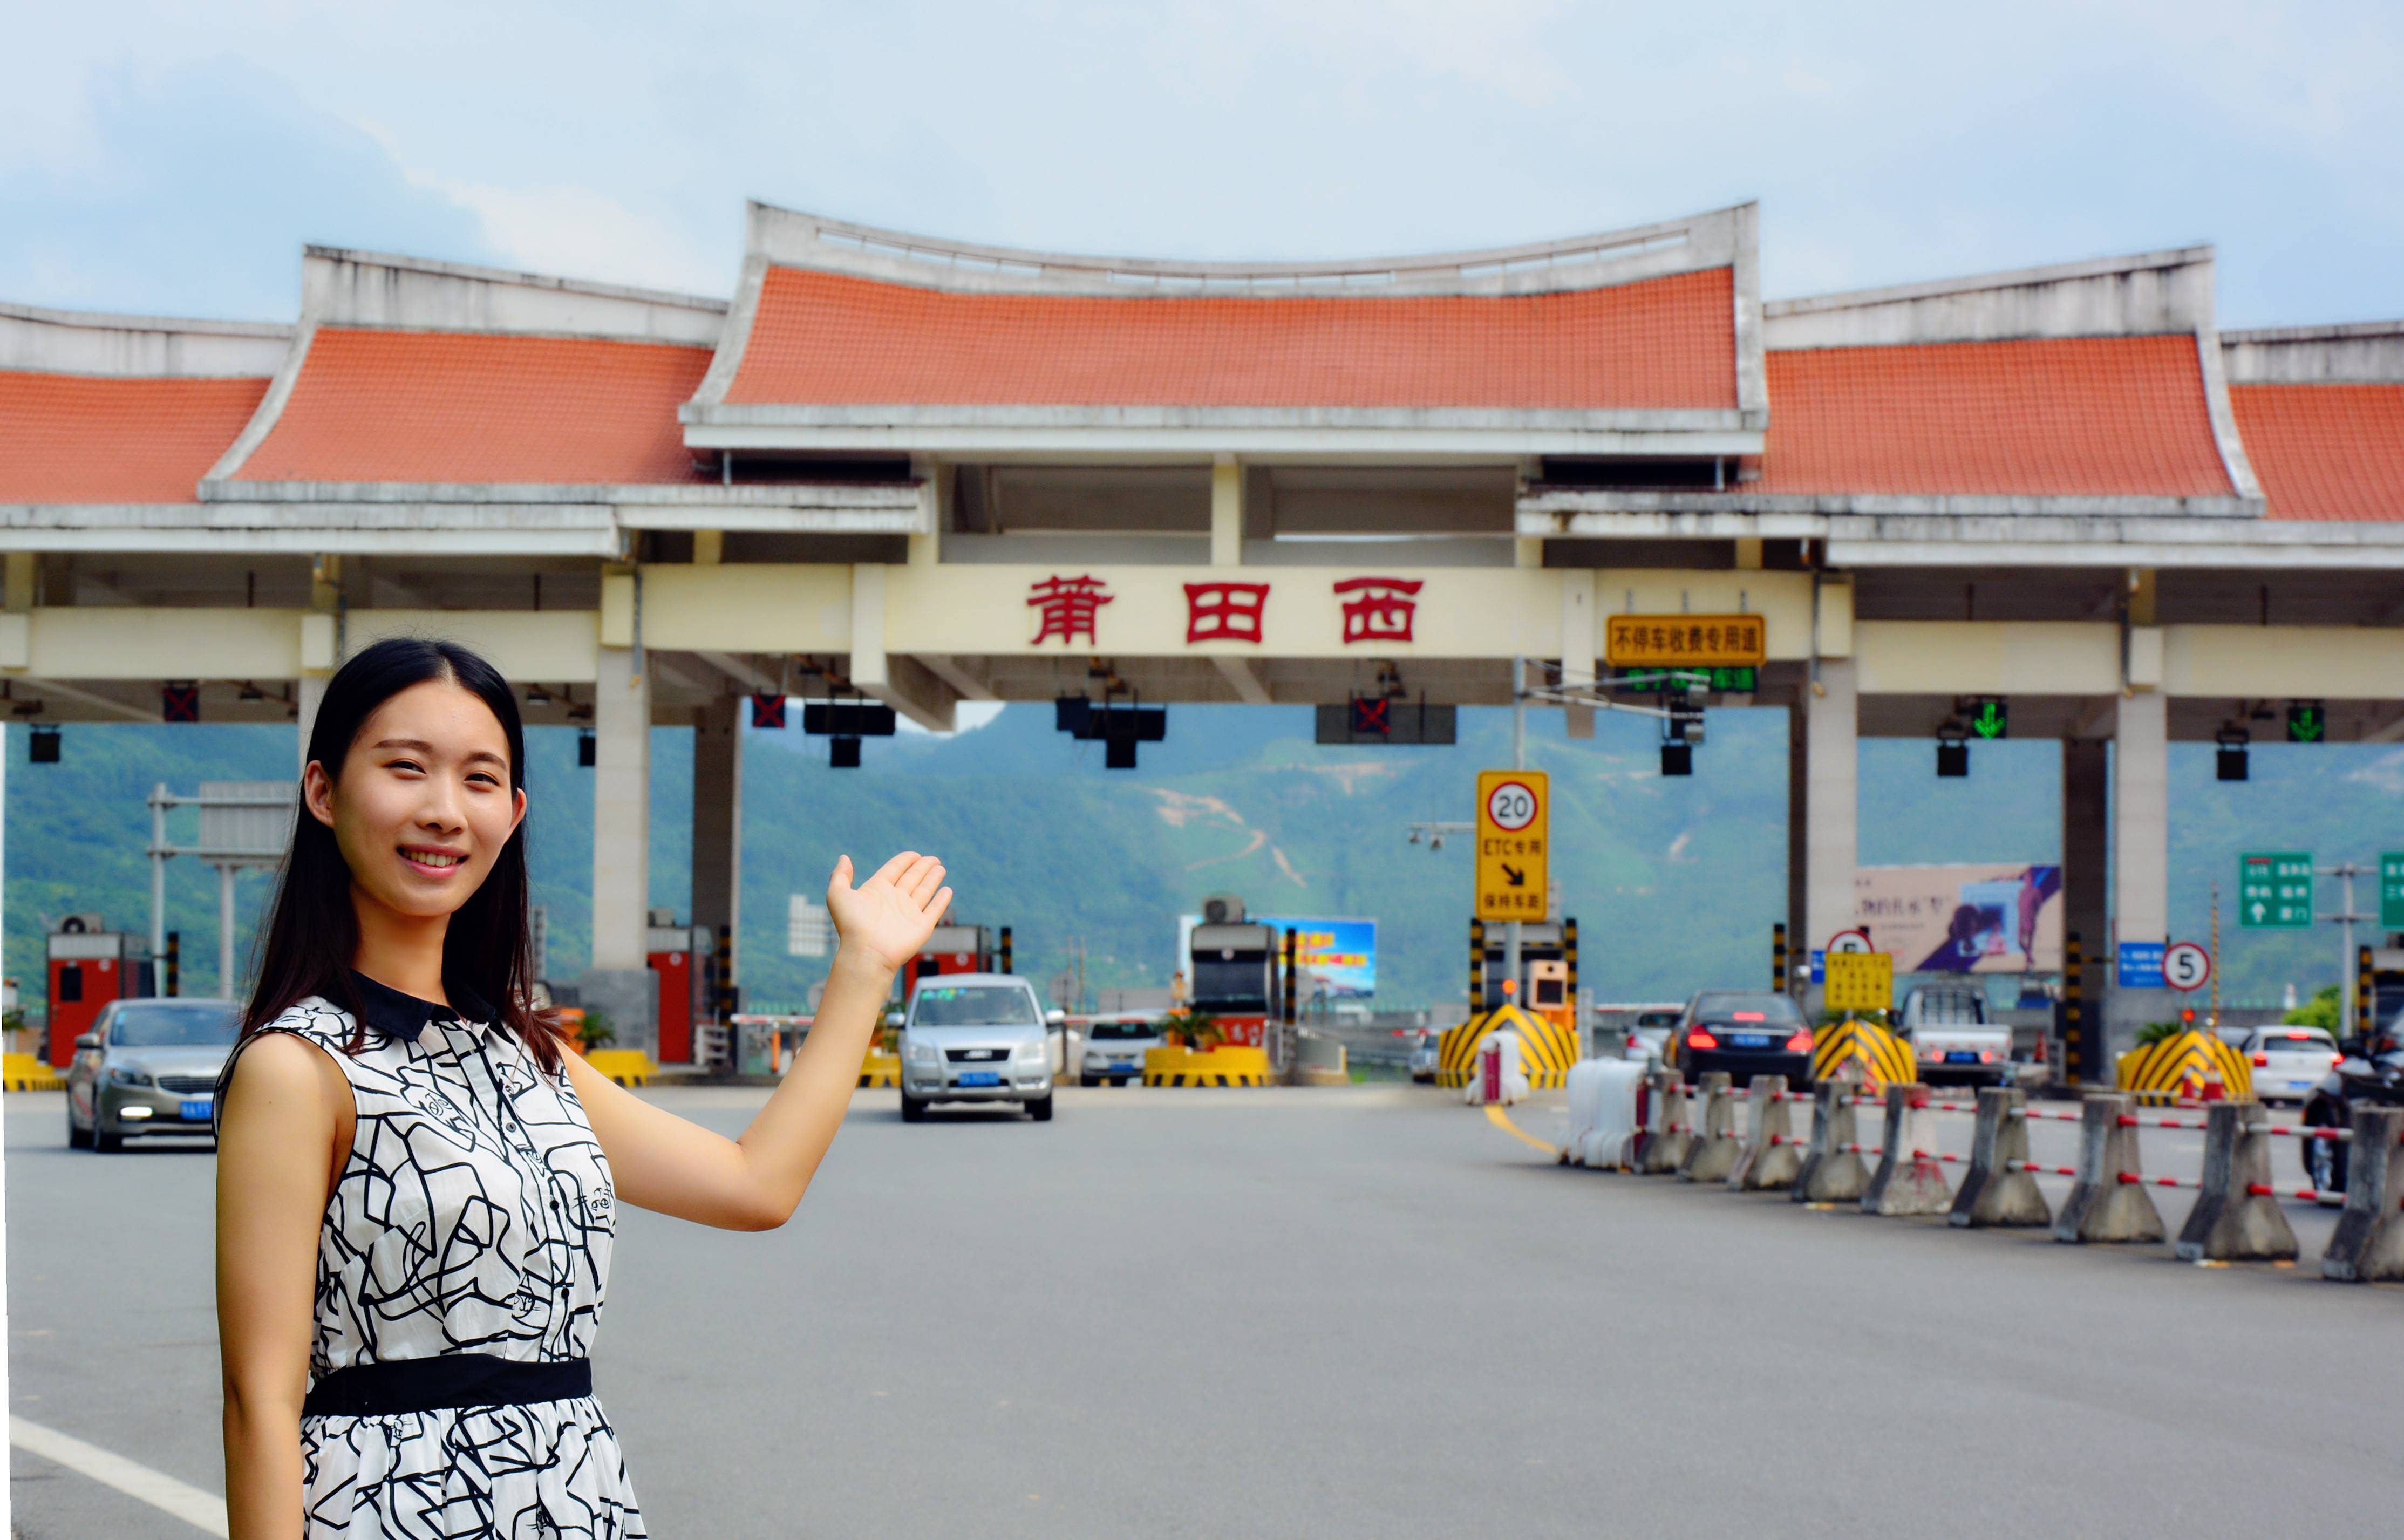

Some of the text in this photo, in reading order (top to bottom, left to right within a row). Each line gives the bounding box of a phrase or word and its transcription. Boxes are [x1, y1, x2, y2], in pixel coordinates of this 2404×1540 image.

[1026, 574, 1425, 647] 莆田西
[1615, 625, 1757, 653] 不停车收费专用道
[1497, 794, 1528, 818] 20
[2178, 953, 2195, 980] 5
